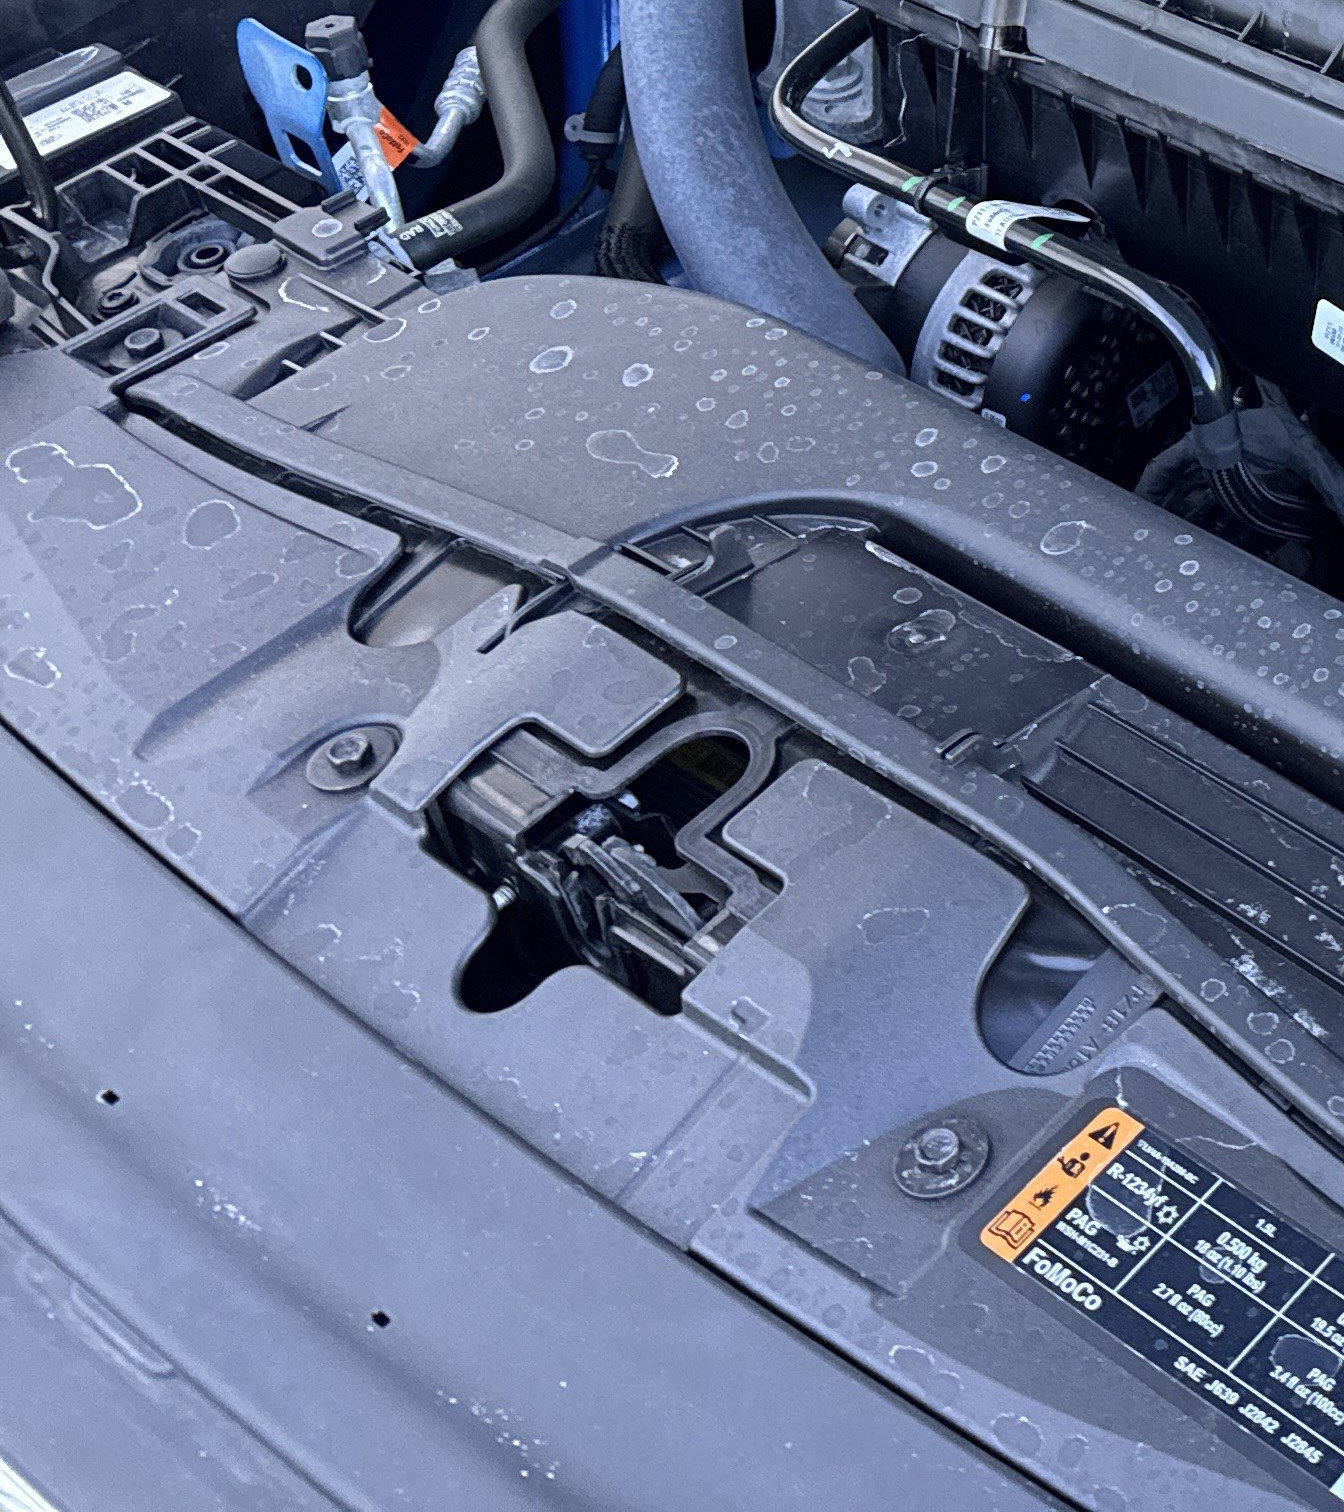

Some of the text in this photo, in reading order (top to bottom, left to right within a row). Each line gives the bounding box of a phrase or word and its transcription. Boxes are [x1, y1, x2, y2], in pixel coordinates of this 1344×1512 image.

[398, 222, 424, 243] RAD
[1104, 1163, 1169, 1211] R-1234yf
[1065, 1207, 1101, 1235] PAG
[1215, 1230, 1269, 1274] 0.500 kg
[1020, 1246, 1106, 1311] FoMoCo
[1240, 1271, 1266, 1294] lbs)
[1186, 1283, 1216, 1307] PAG
[1310, 1316, 1335, 1337] 19.5
[1306, 1367, 1337, 1391] PAG
[1172, 1355, 1323, 1465] SAE J639 J2842 J2845
